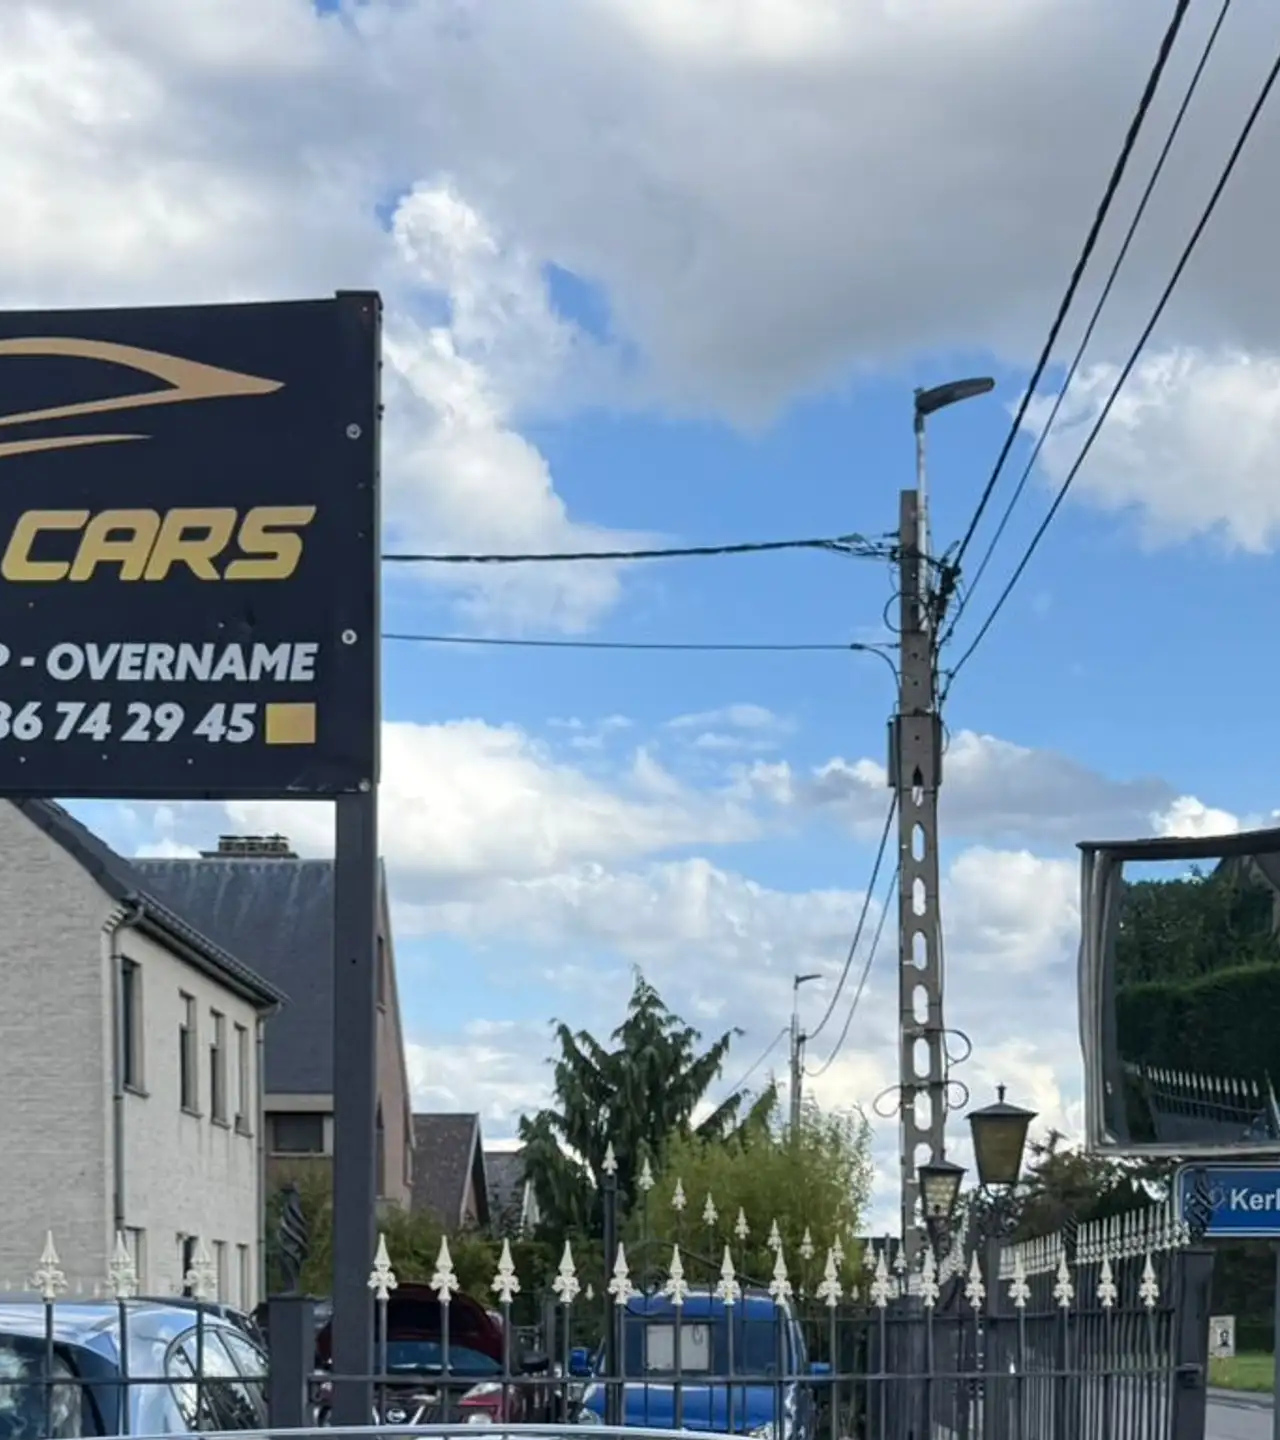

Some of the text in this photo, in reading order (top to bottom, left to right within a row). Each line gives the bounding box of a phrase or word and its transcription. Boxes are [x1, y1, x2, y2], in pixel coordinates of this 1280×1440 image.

[0, 505, 317, 582] CARS
[46, 642, 319, 682] OVERNAME
[54, 701, 112, 742] 74
[120, 701, 185, 743] 29
[192, 702, 257, 743] 45
